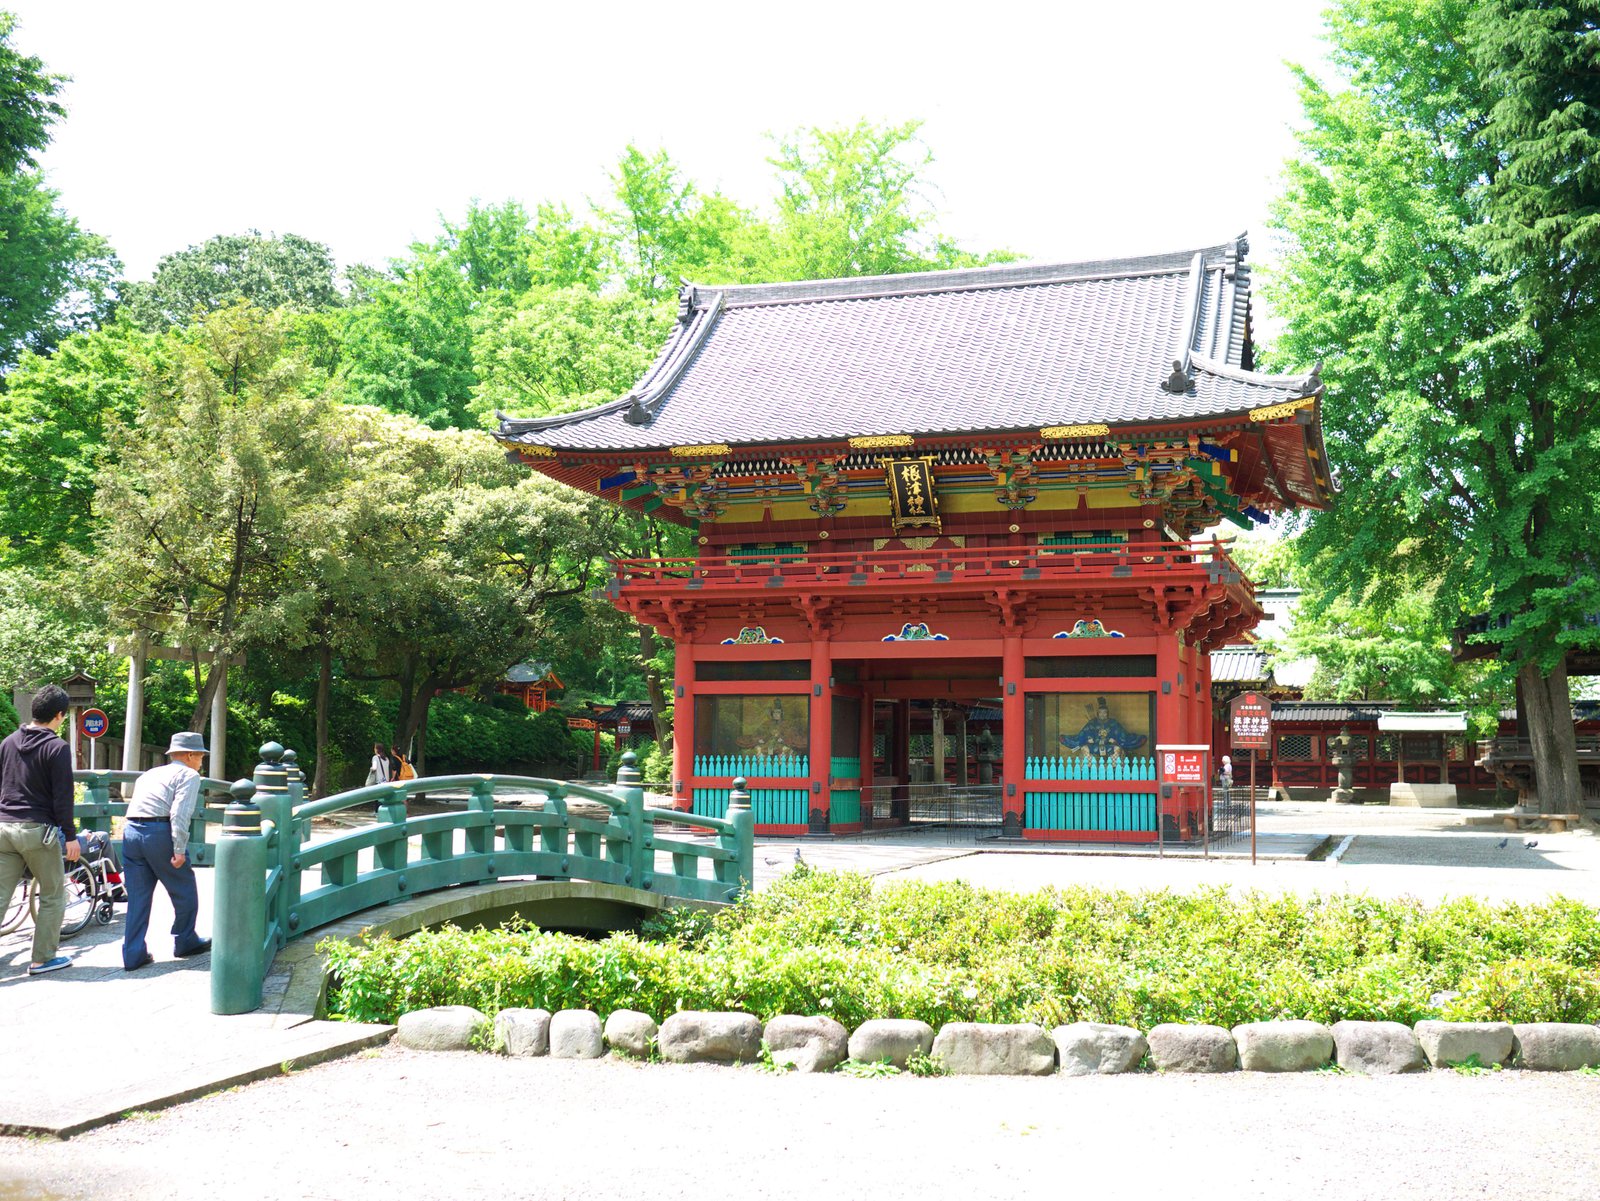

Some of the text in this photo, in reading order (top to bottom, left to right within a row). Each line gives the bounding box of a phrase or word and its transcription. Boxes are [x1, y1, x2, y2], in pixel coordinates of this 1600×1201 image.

[901, 464, 926, 516] 根津神社
[1233, 716, 1269, 725] 根津神社
